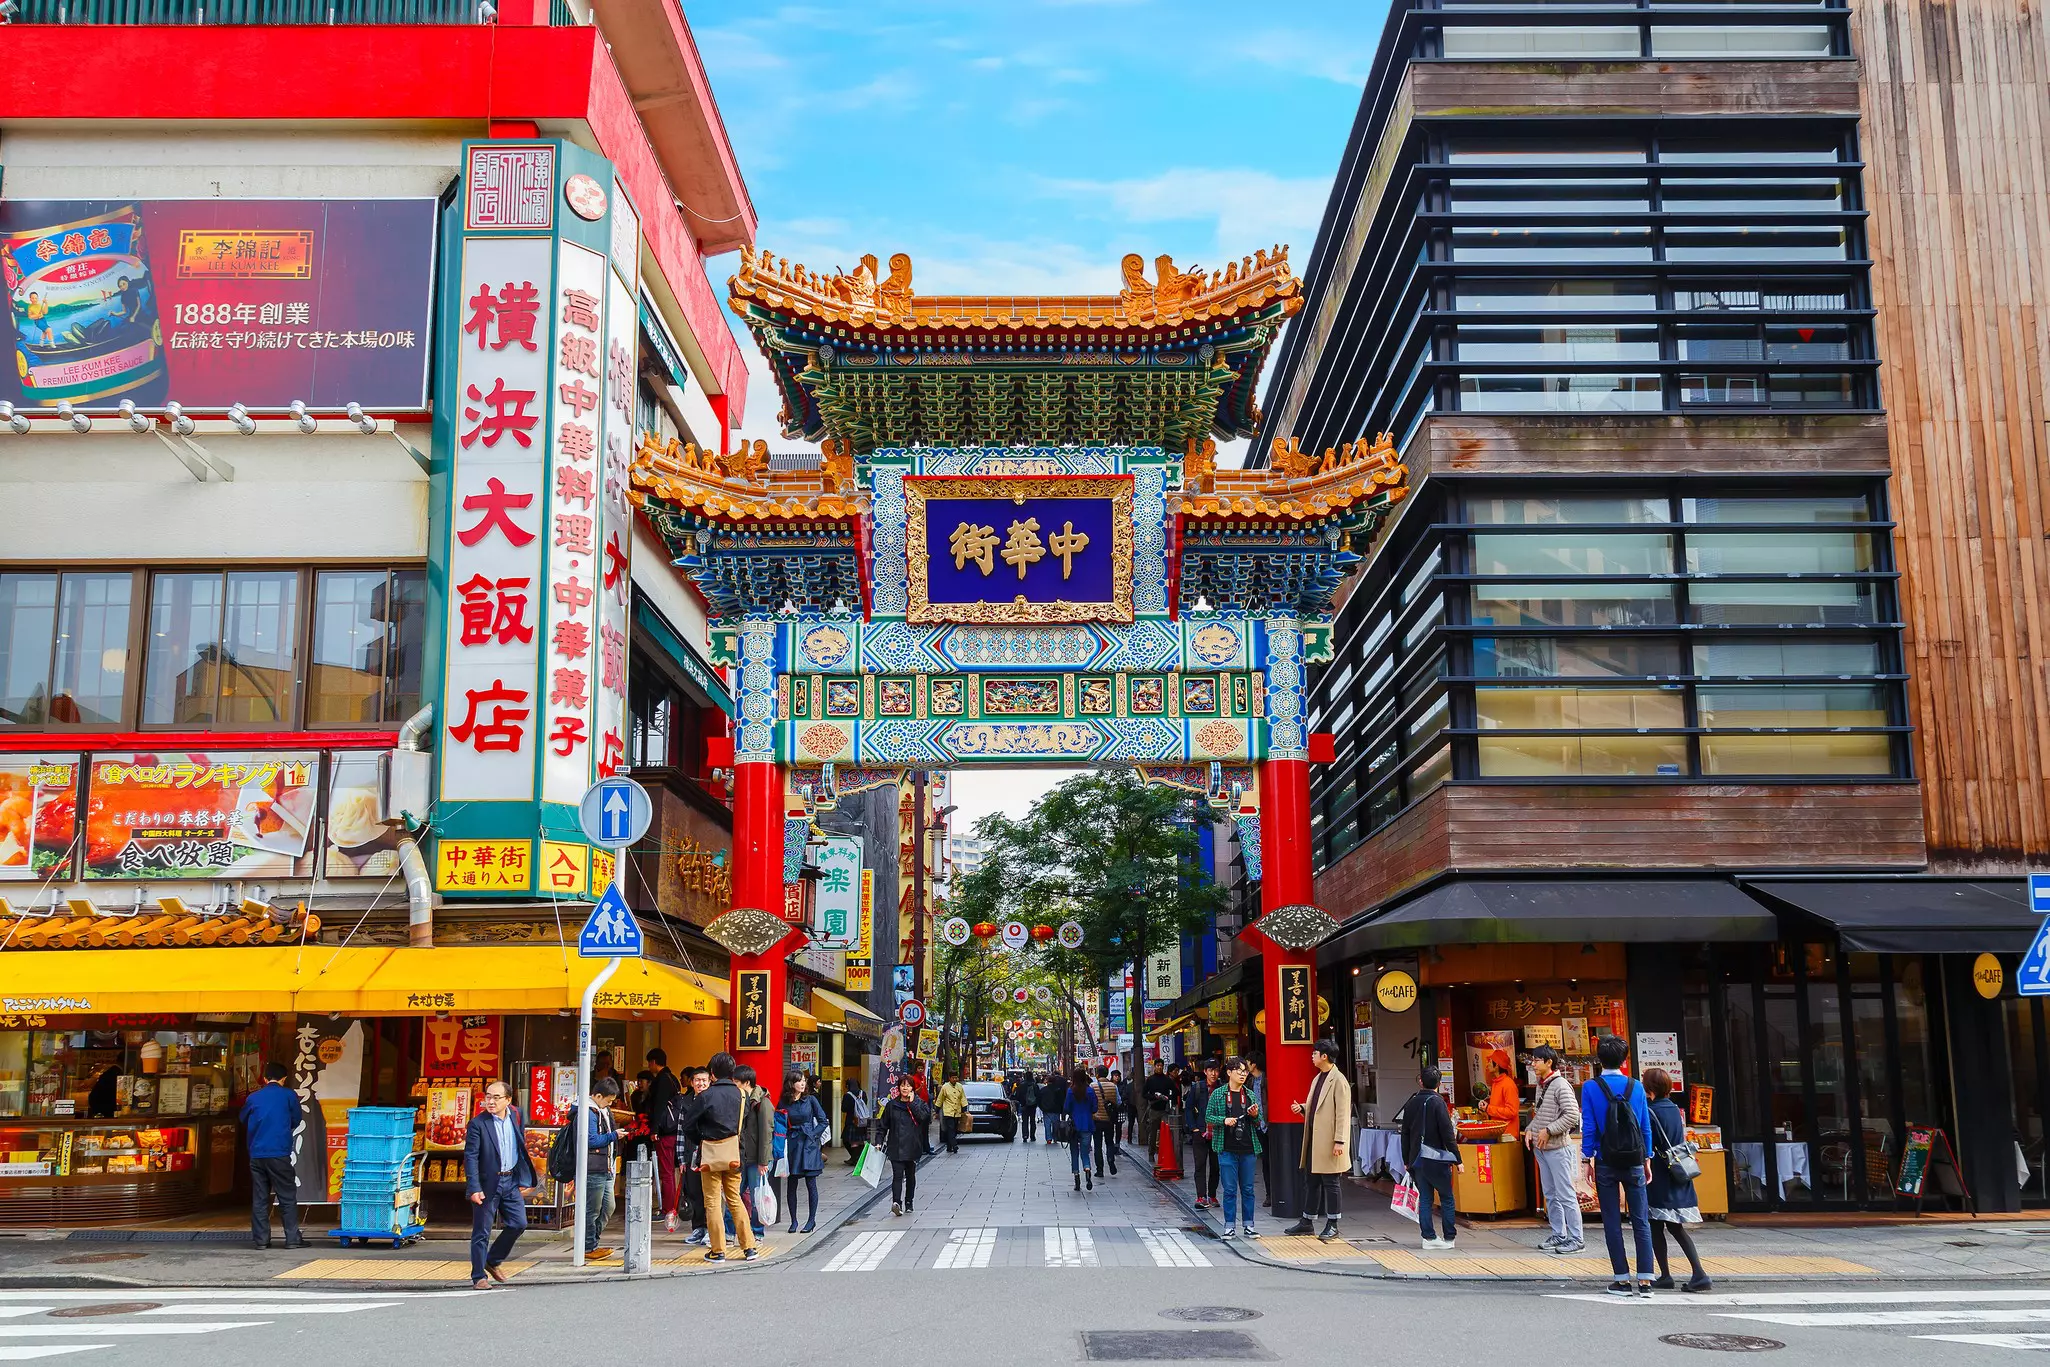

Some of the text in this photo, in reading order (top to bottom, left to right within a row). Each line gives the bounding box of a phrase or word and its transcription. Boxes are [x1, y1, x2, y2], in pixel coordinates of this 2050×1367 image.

[36, 229, 112, 261] 李錦記
[211, 239, 281, 260] 李錦記
[208, 261, 280, 270] LEE KUM KEE
[174, 302, 310, 326] 1888年創業
[170, 330, 416, 350] 伝統を守り続けてきた本場の味
[42, 355, 144, 387] PREMIUM OYSTER SAUCE
[63, 355, 121, 376] LEE KUM KEE
[448, 280, 541, 754] 横浜大飯店
[289, 770, 306, 785] 1位
[116, 840, 235, 871] 食べ放題
[446, 845, 527, 870] 中華街
[445, 871, 525, 886] 大通り入口
[549, 848, 581, 888] 入口
[823, 867, 851, 936] 楽園
[859, 871, 871, 958] 中国料理世界チャンピオン
[847, 967, 871, 979] 100円
[1156, 958, 1172, 988] 新館
[1984, 968, 2001, 984] CAFE
[407, 992, 455, 1008] 大粒甘栗
[1379, 985, 1415, 998] The CAFE
[2, 996, 92, 1012] アンニンソフトクリーム
[905, 1007, 920, 1019] 30
[426, 1015, 498, 1077] 甘栗
